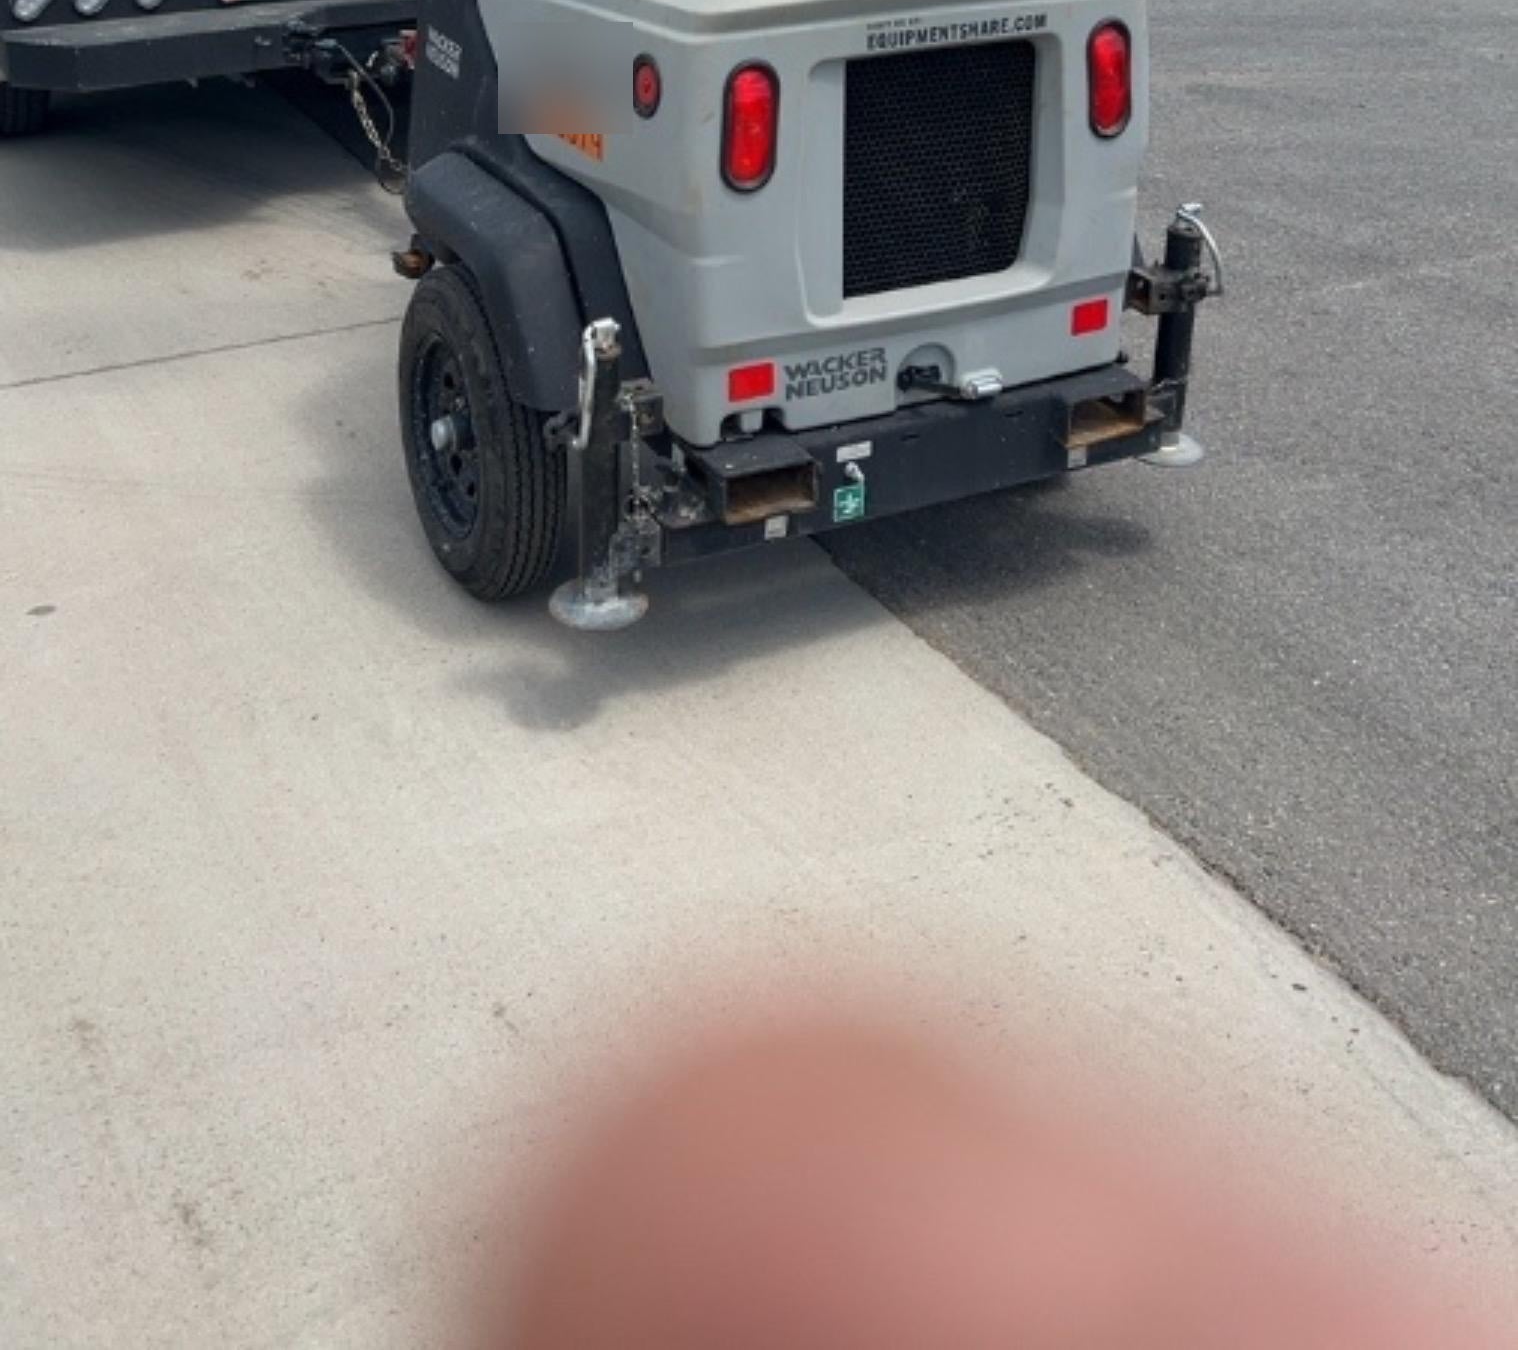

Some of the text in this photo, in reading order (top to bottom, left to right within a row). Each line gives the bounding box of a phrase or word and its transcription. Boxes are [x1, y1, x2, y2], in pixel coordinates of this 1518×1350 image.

[866, 14, 1047, 50] EQUIPMENTSHARE.COM
[783, 347, 888, 382] WACKER
[785, 365, 887, 402] NEUSON
